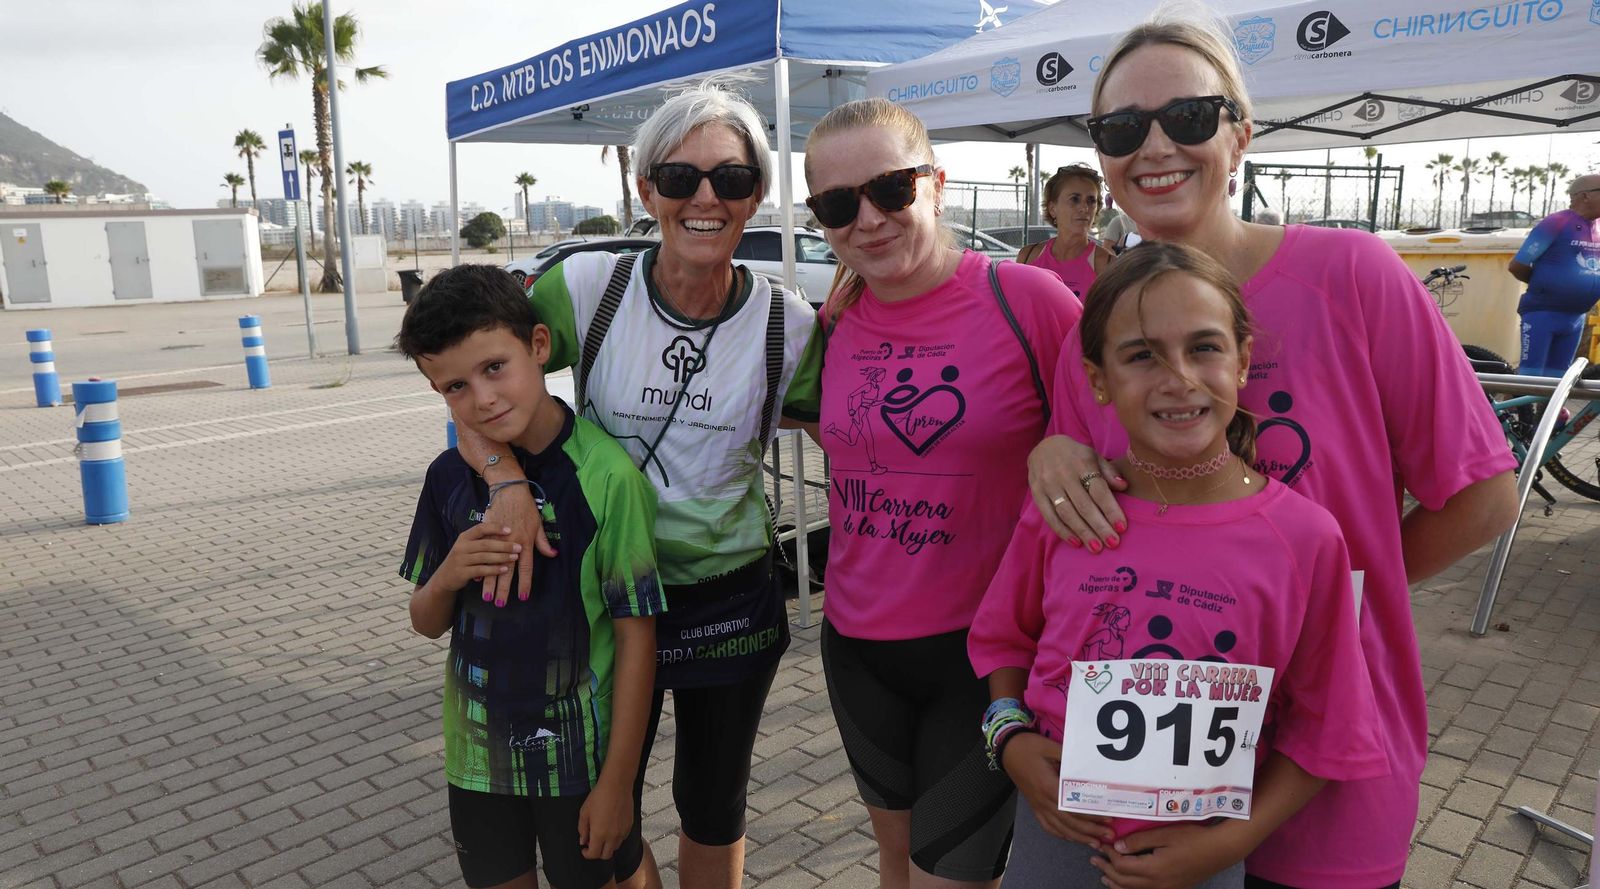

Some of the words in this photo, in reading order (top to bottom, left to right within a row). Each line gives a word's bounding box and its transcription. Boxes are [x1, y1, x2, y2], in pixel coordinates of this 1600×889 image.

[471, 84, 498, 112] C.D.
[502, 64, 535, 102] MTB
[539, 49, 574, 89] LOS
[578, 3, 717, 76] ENMONAOS
[833, 478, 866, 512] VIII
[865, 488, 955, 520] Carrera
[843, 514, 854, 536] de
[858, 515, 879, 538] la
[881, 518, 956, 555] Mujer
[1177, 595, 1190, 606] de
[1193, 598, 1224, 613] Cádiz
[1179, 584, 1237, 605] Diputación
[680, 627, 702, 640] CLUB
[704, 617, 750, 637] DEPORTIVO
[1177, 664, 1258, 685] CARRERA
[1121, 678, 1167, 696] POR
[1174, 680, 1201, 699] LA
[1208, 683, 1263, 702] MUJER
[1096, 699, 1239, 767] 915
